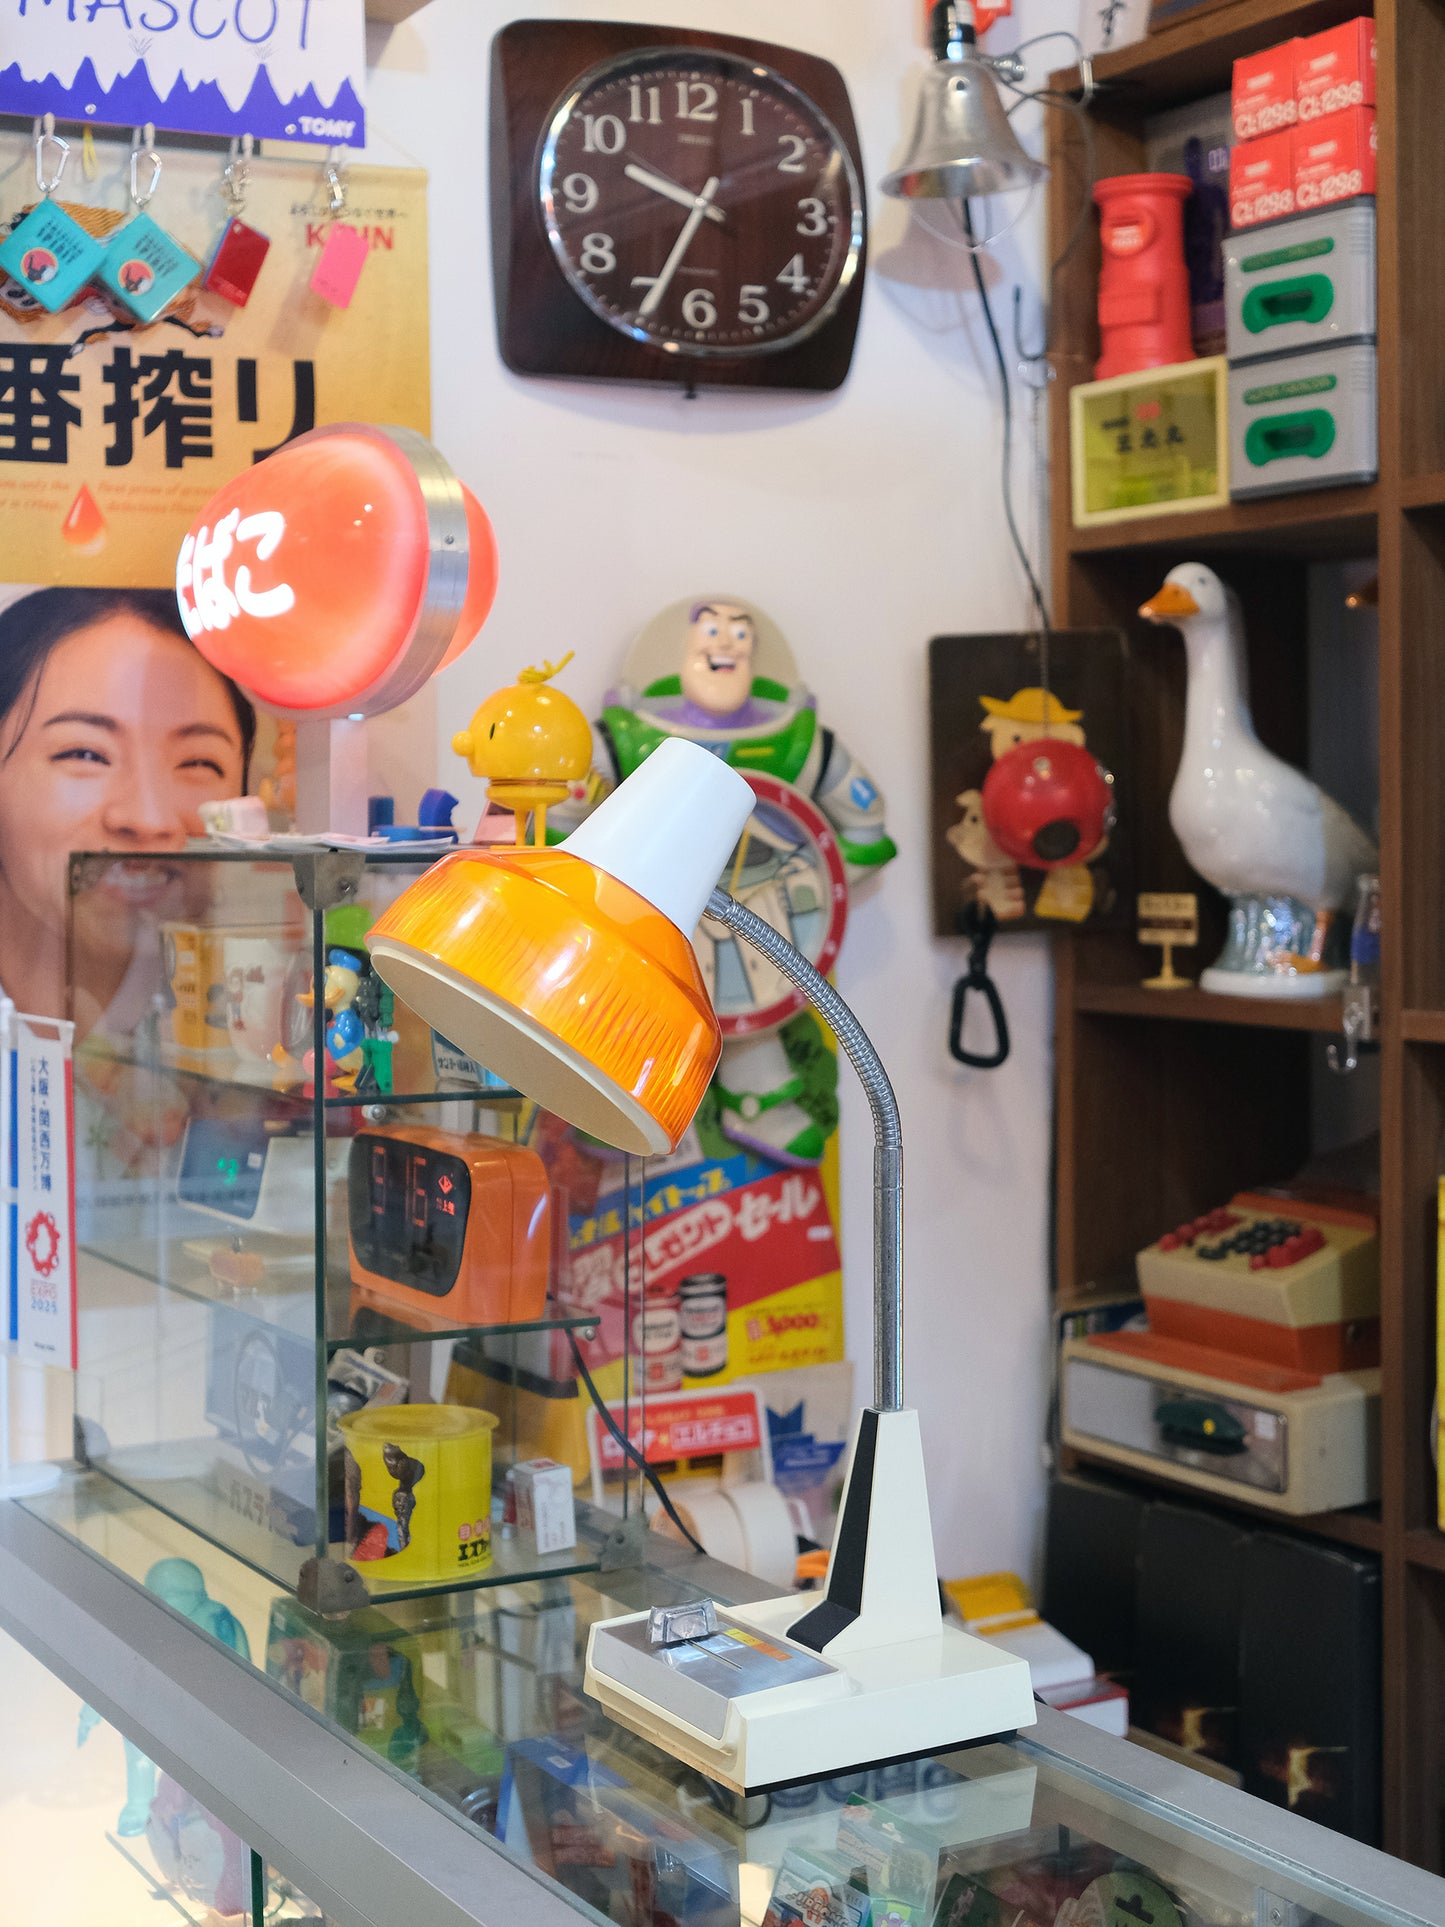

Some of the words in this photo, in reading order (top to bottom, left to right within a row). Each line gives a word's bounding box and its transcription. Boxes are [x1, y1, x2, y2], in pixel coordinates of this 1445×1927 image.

[629, 85, 662, 124] 11
[676, 81, 718, 121] 12
[740, 98, 755, 135] 1
[298, 116, 356, 139] TOMY
[583, 114, 626, 154] 10
[777, 135, 808, 173] 2
[562, 173, 599, 214] 9
[305, 223, 395, 250] KIN
[797, 198, 828, 237] 3
[580, 233, 616, 274] 8
[776, 253, 811, 293] 4
[682, 289, 717, 329] 6
[738, 285, 770, 324] 5
[0, 343, 316, 468] 番搾り
[38, 1055, 52, 1193] 大阪・関西万博
[736, 1175, 821, 1241] セール
